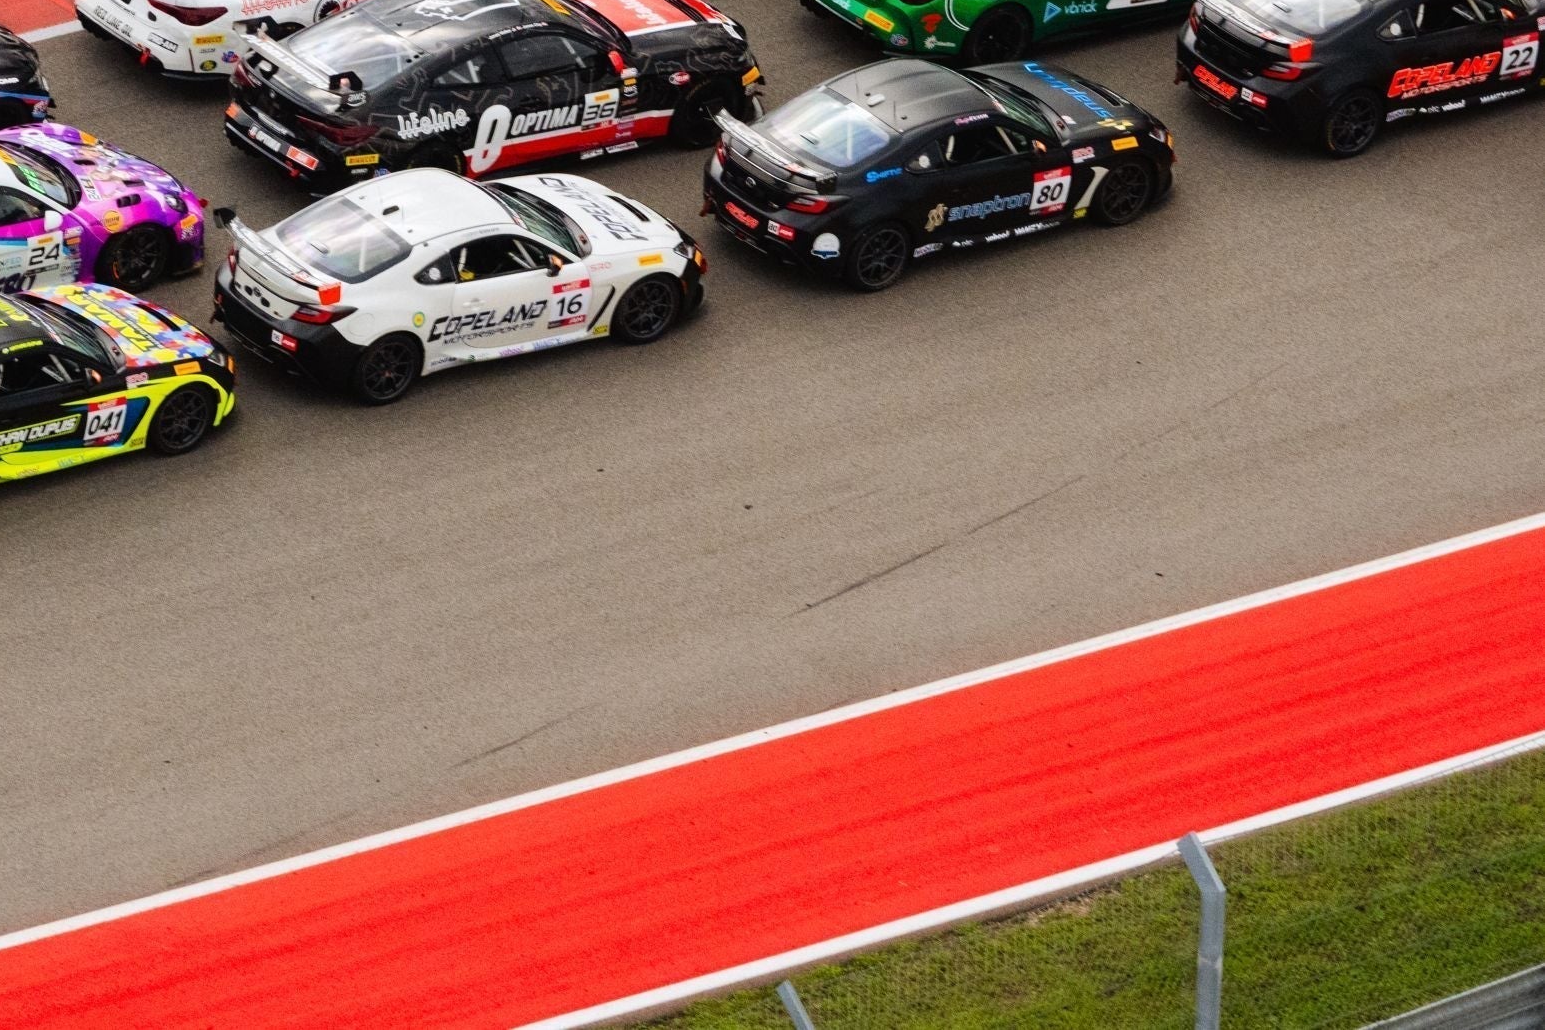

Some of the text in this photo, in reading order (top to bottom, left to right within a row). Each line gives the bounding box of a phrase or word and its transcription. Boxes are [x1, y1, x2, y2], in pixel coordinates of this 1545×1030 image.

[1508, 46, 1533, 70] 22
[1387, 52, 1502, 98] COPELAND
[511, 104, 579, 136] OPTIMA
[949, 191, 1032, 222] snaptron
[1037, 182, 1063, 205] 80
[29, 243, 60, 267] 24
[557, 293, 583, 317] 16
[427, 299, 548, 343] COPELAND
[88, 410, 123, 436] 041
